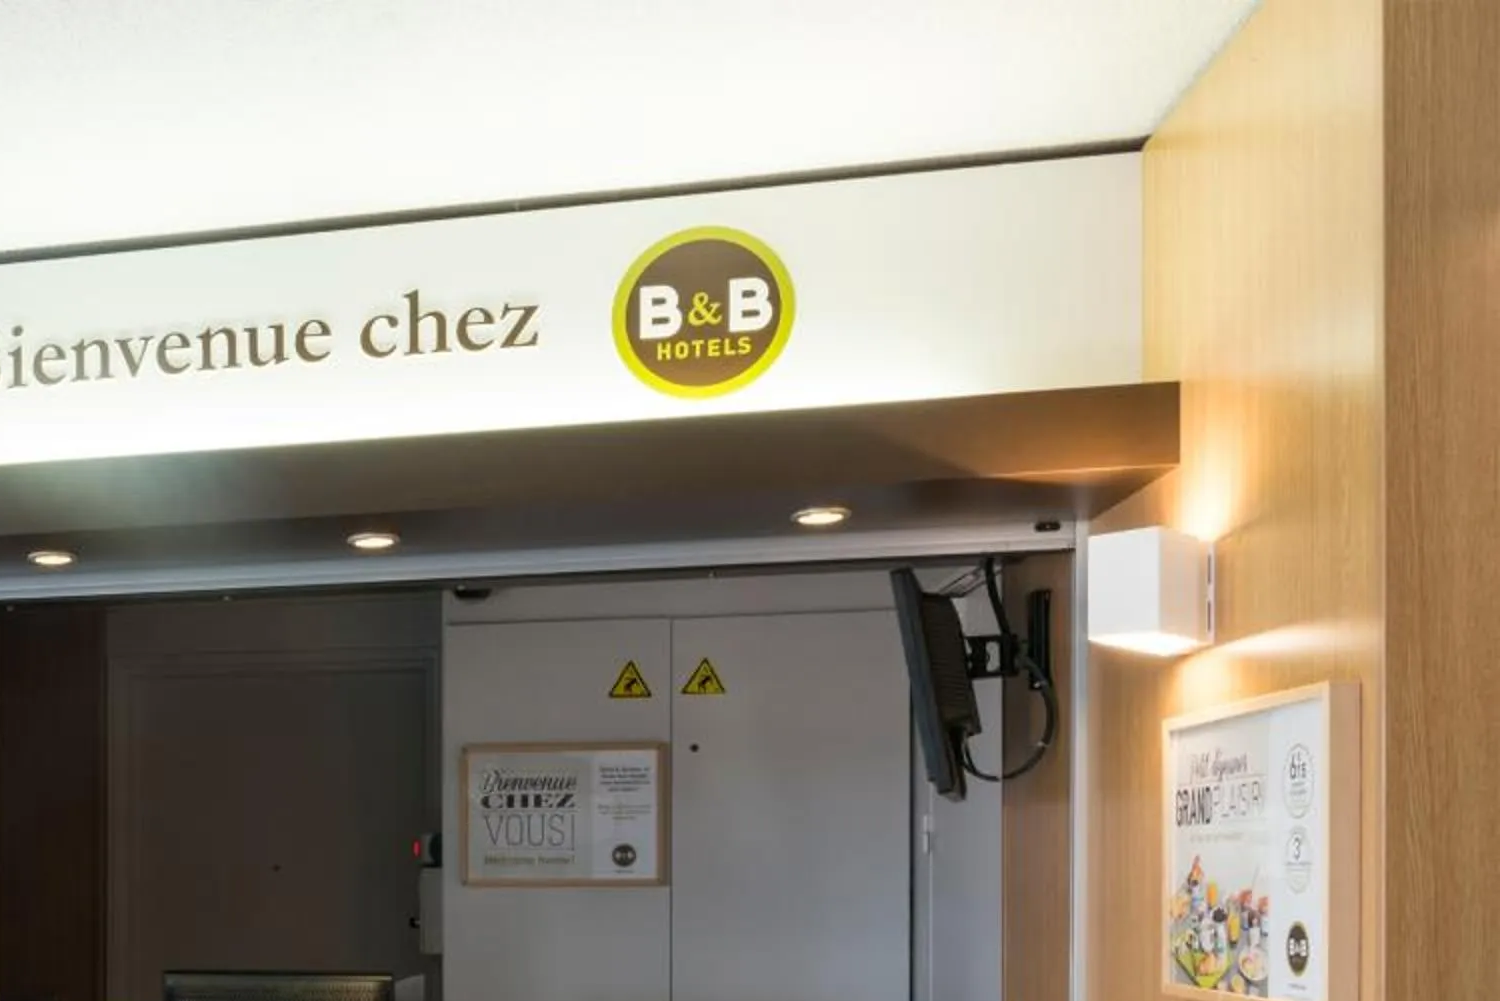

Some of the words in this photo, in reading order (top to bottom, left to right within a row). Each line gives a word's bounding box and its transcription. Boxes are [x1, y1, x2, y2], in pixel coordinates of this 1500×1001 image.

[360, 289, 539, 358] chez
[639, 276, 773, 340] B&B
[656, 336, 752, 361] HOTELS
[481, 794, 575, 808] CHEZ
